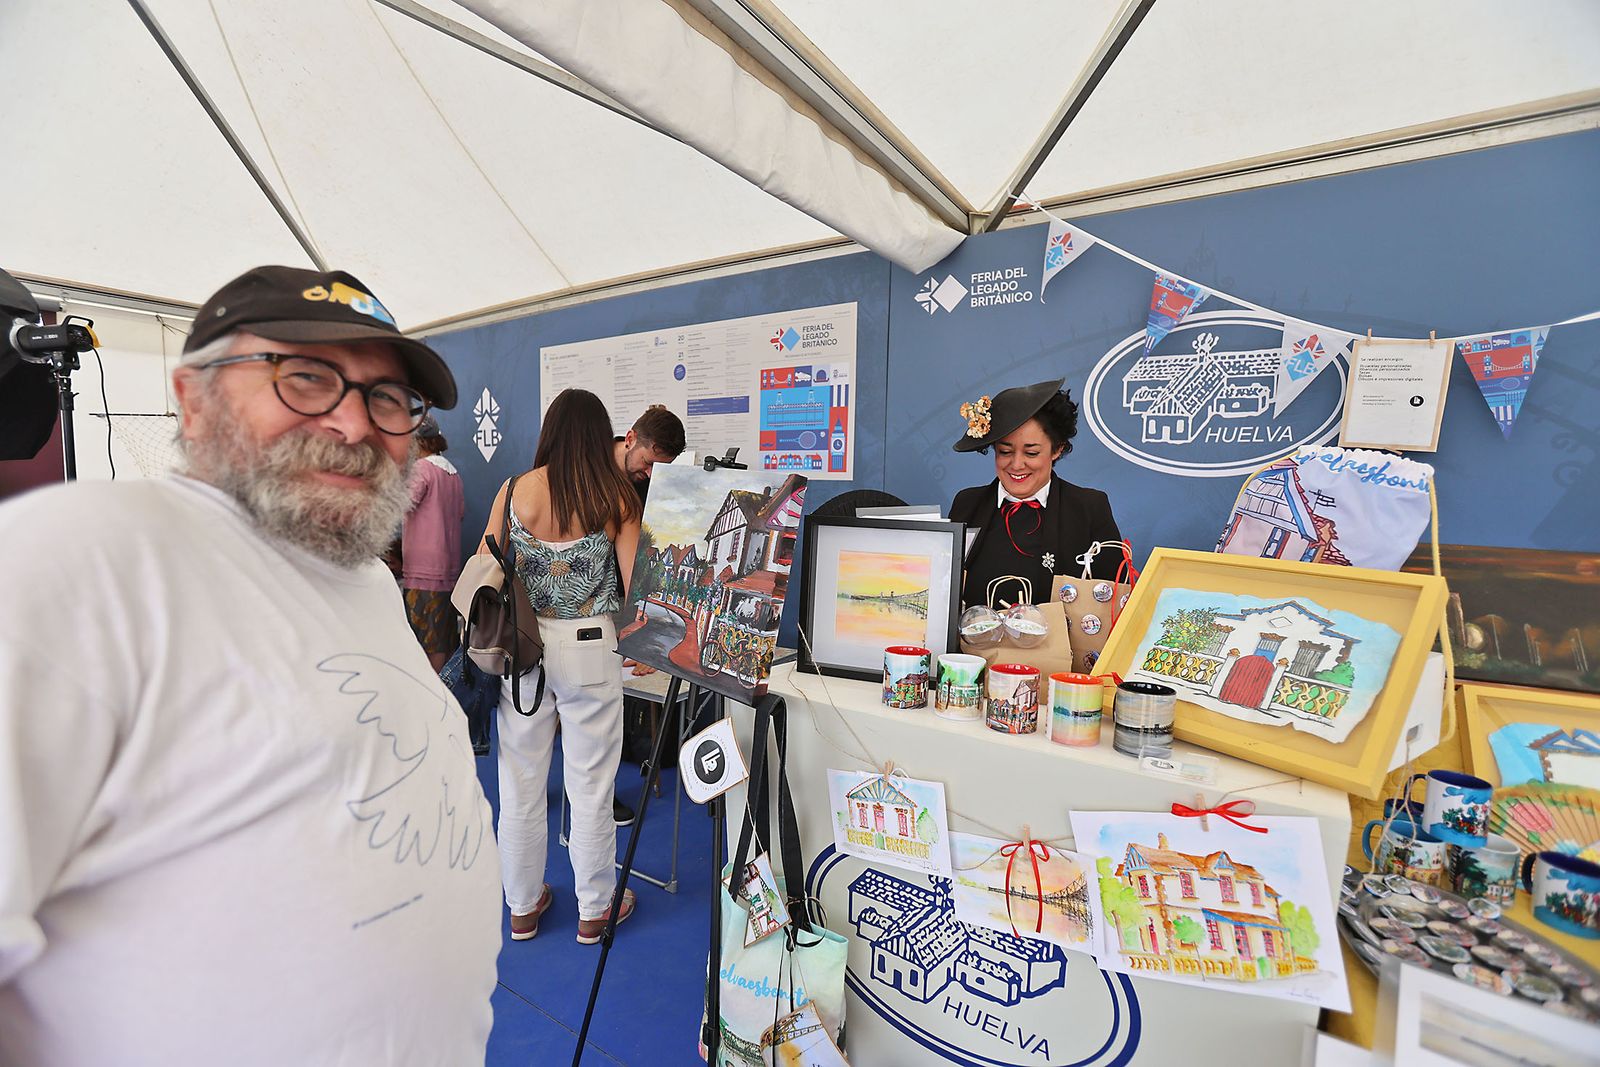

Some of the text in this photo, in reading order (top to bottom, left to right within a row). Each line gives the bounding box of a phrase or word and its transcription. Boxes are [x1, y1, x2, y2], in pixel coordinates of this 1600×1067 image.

[971, 267, 1028, 284] FERIA DEL
[970, 280, 1018, 296] LEGADO
[970, 290, 1033, 308] BRITÁNICO
[802, 322, 835, 333] FERIA DEL
[802, 331, 830, 341] LEGADO
[476, 429, 500, 447] FLB
[1205, 425, 1294, 443] HUELVA
[943, 996, 1050, 1062] HUELVA
